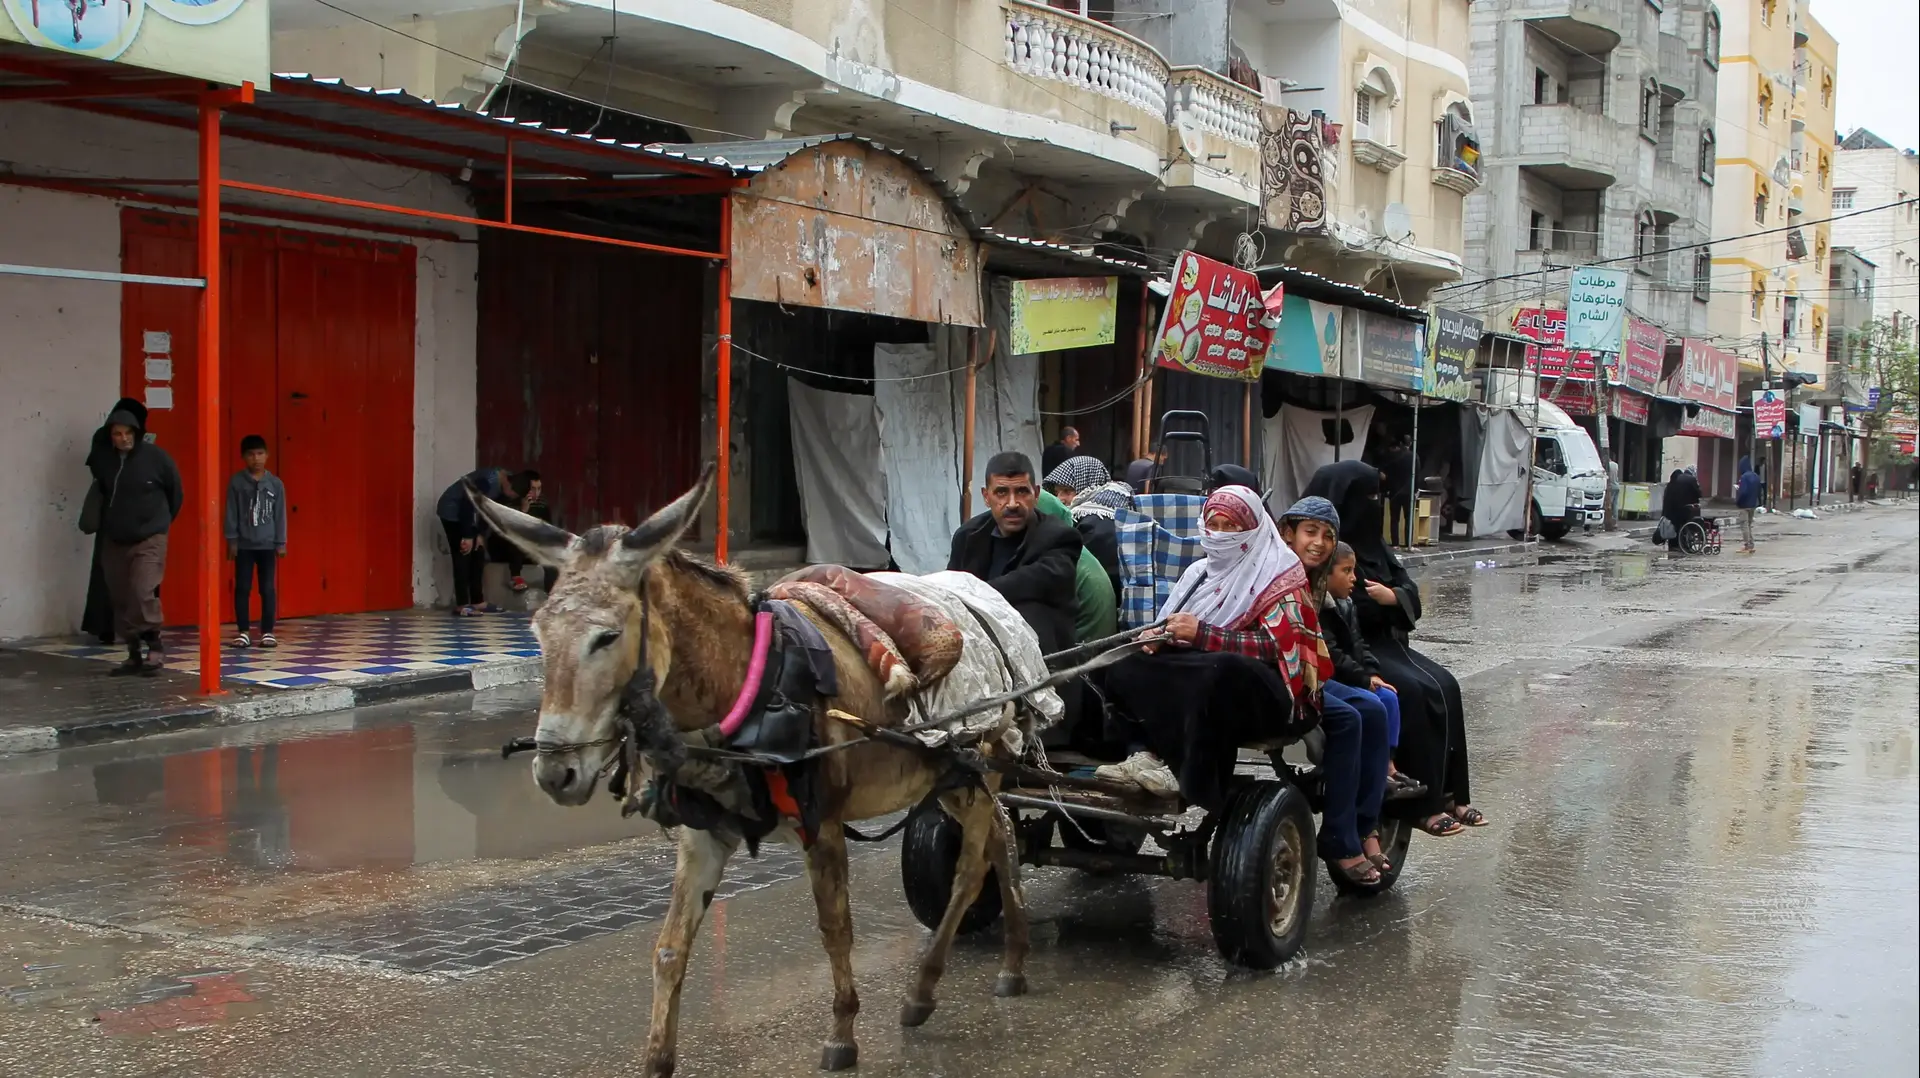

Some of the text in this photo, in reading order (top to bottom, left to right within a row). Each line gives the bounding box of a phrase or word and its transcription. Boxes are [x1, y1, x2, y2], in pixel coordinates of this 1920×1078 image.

[1579, 276, 1616, 289] مرطبات
[1571, 292, 1623, 308] وجاتوهات
[1578, 310, 1609, 322] الشام
[1461, 322, 1479, 343] مطعم
